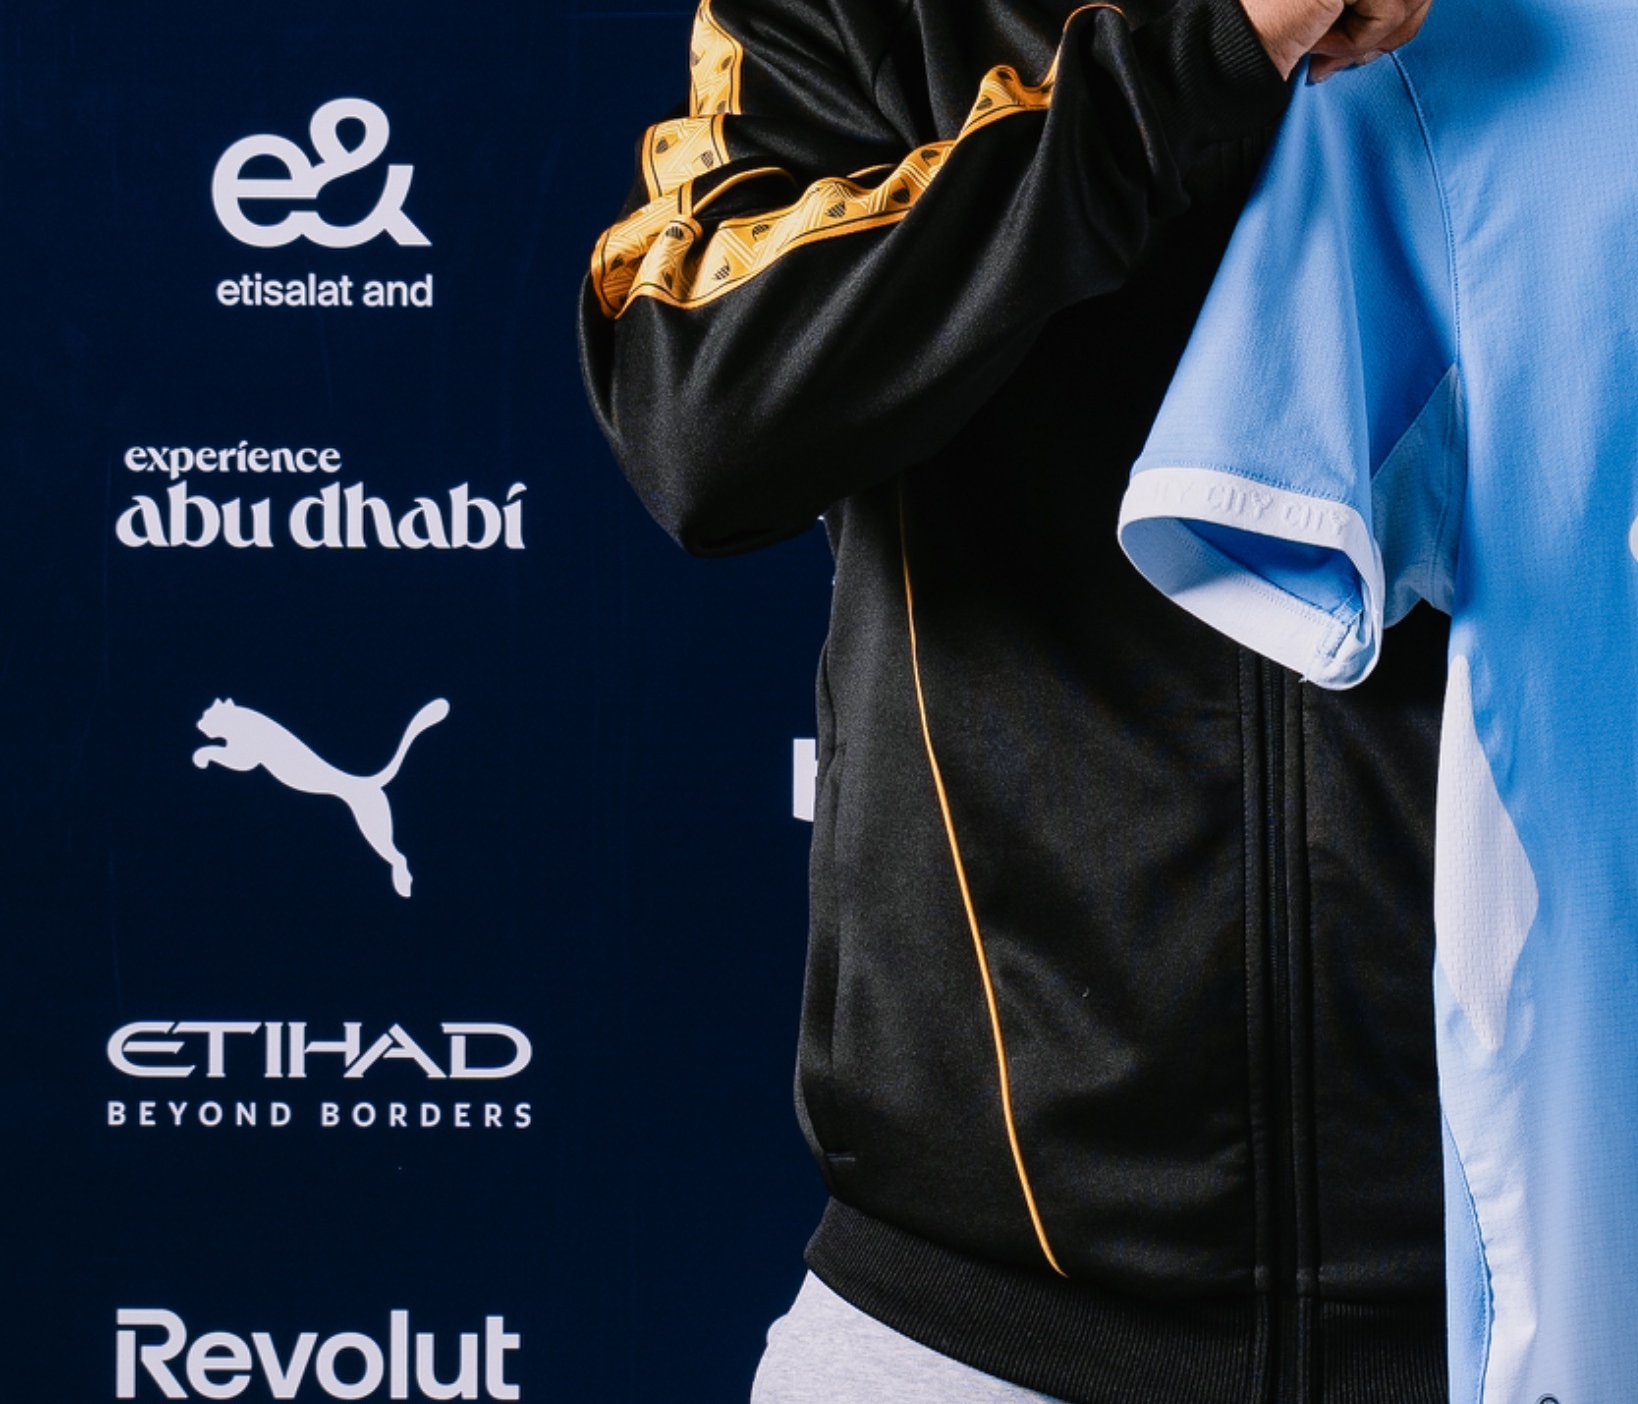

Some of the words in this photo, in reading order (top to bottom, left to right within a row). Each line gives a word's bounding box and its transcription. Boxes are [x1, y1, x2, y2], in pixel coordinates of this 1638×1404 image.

[215, 271, 354, 308] etisalat
[361, 273, 434, 308] and
[115, 479, 275, 549] abu
[106, 1020, 533, 1080] ETIHAD
[107, 1100, 292, 1127] BEYOND
[320, 1101, 532, 1129] BORDERS
[115, 1307, 521, 1401] Revolut
